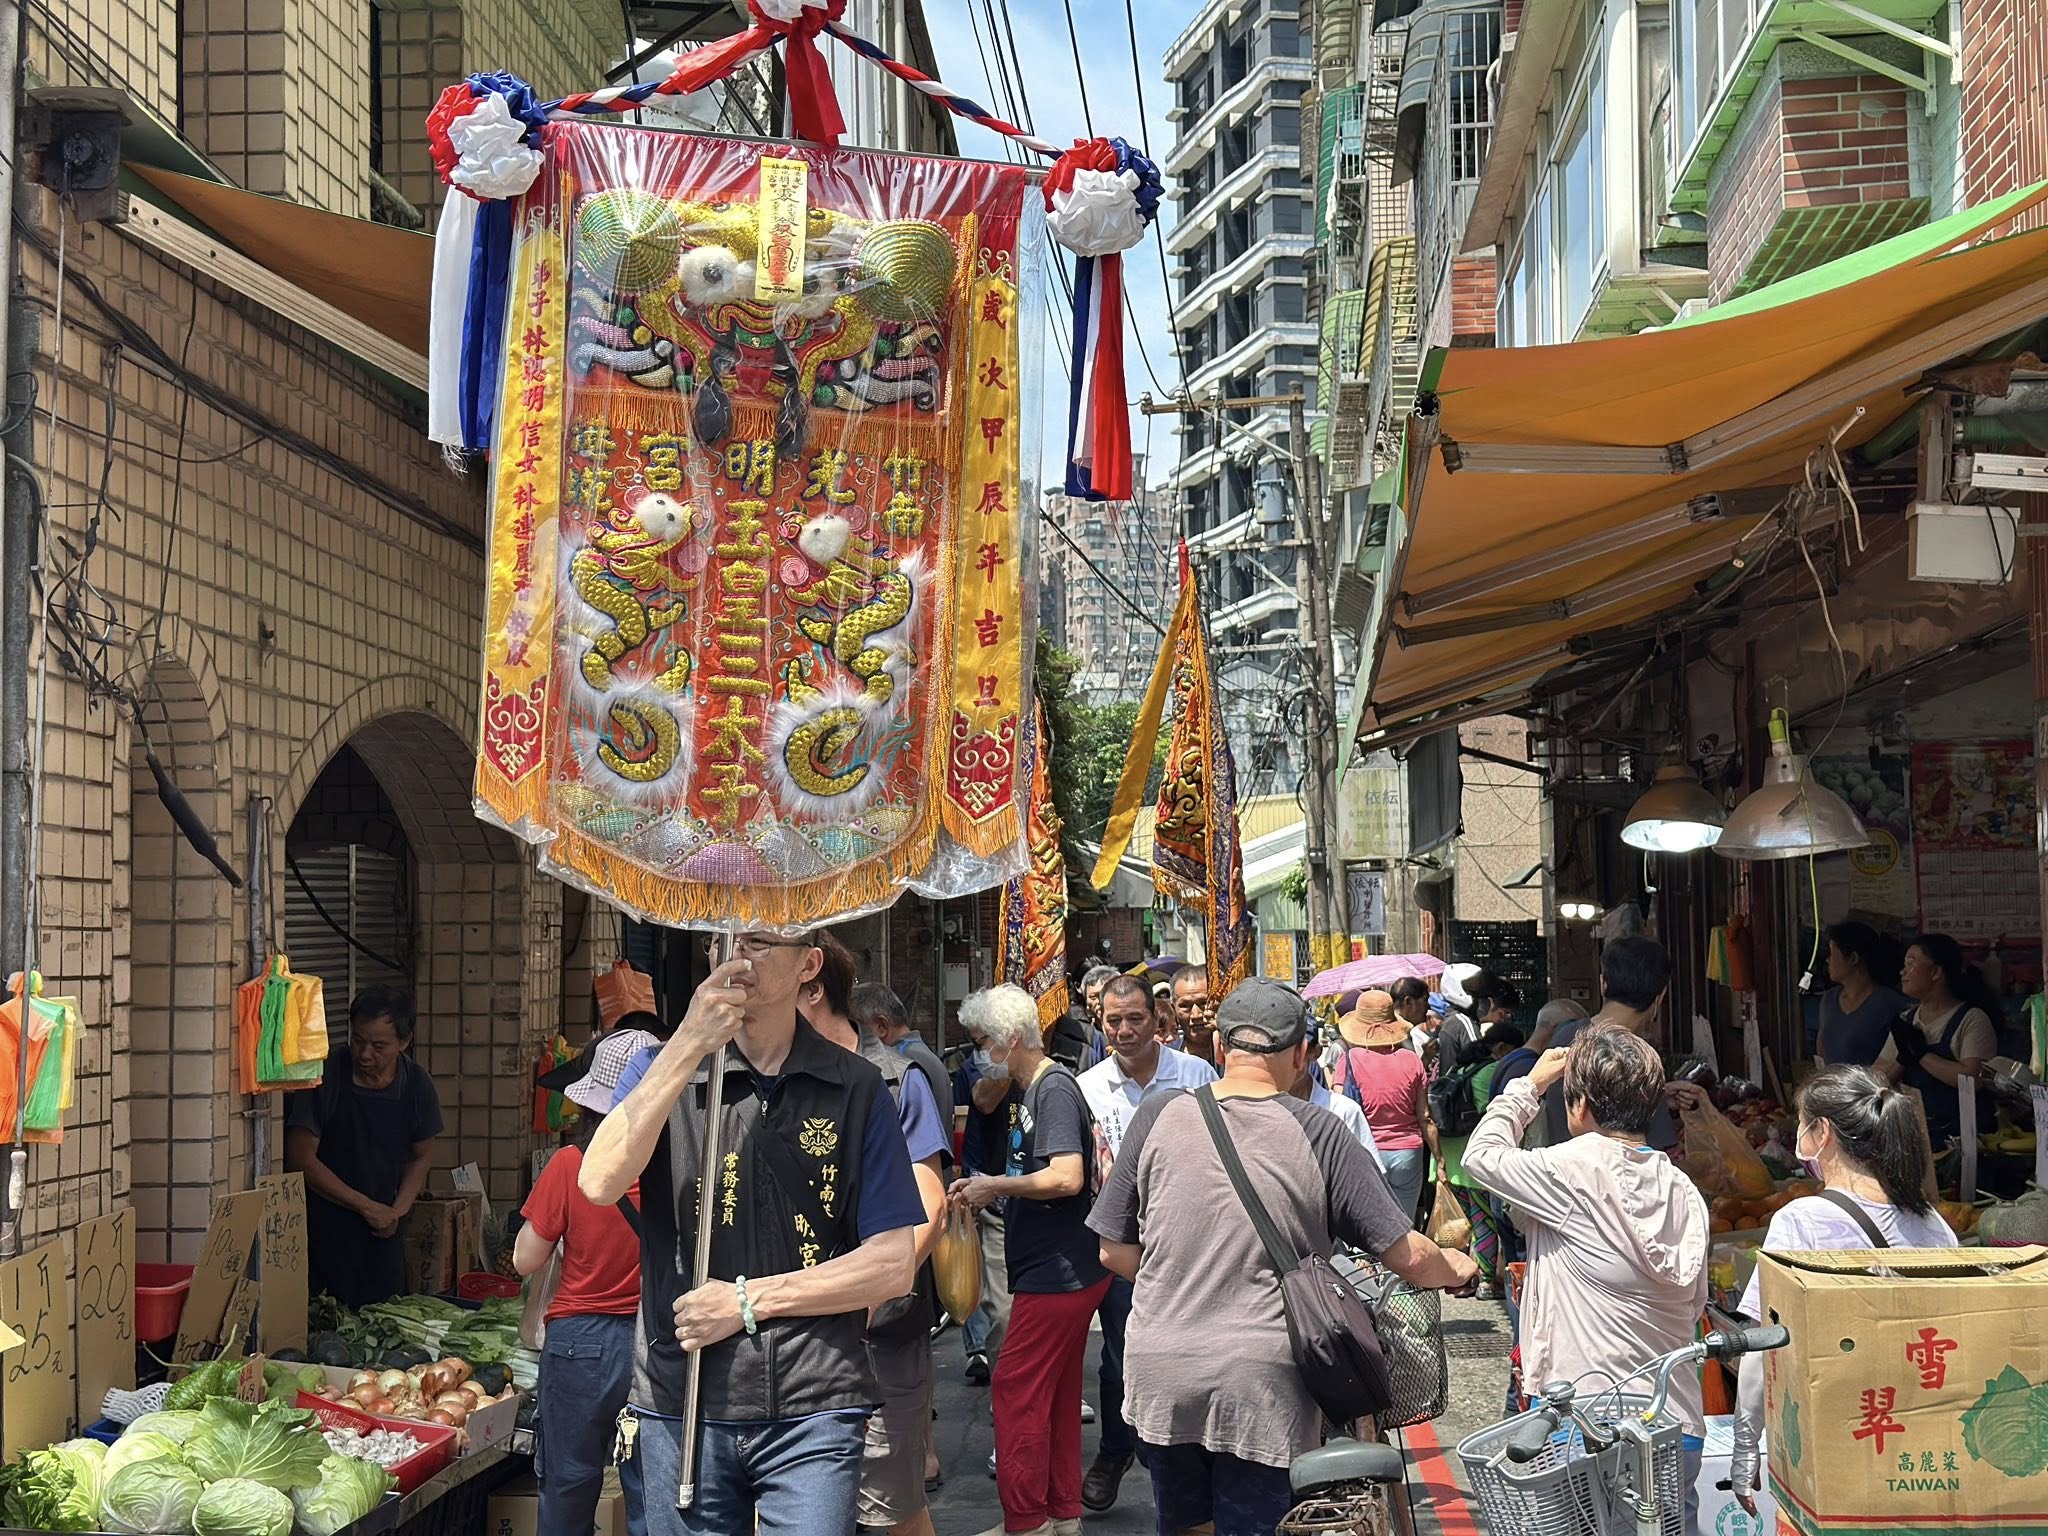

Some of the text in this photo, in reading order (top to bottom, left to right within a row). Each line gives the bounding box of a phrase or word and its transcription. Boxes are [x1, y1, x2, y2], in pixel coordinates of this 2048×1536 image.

[974, 289, 1008, 708] 歲次甲辰年吉旦
[721, 1151, 740, 1227] 常務委員
[1885, 1478, 1961, 1493] TAIWAN
[1897, 1450, 1961, 1473] 高麗菜
